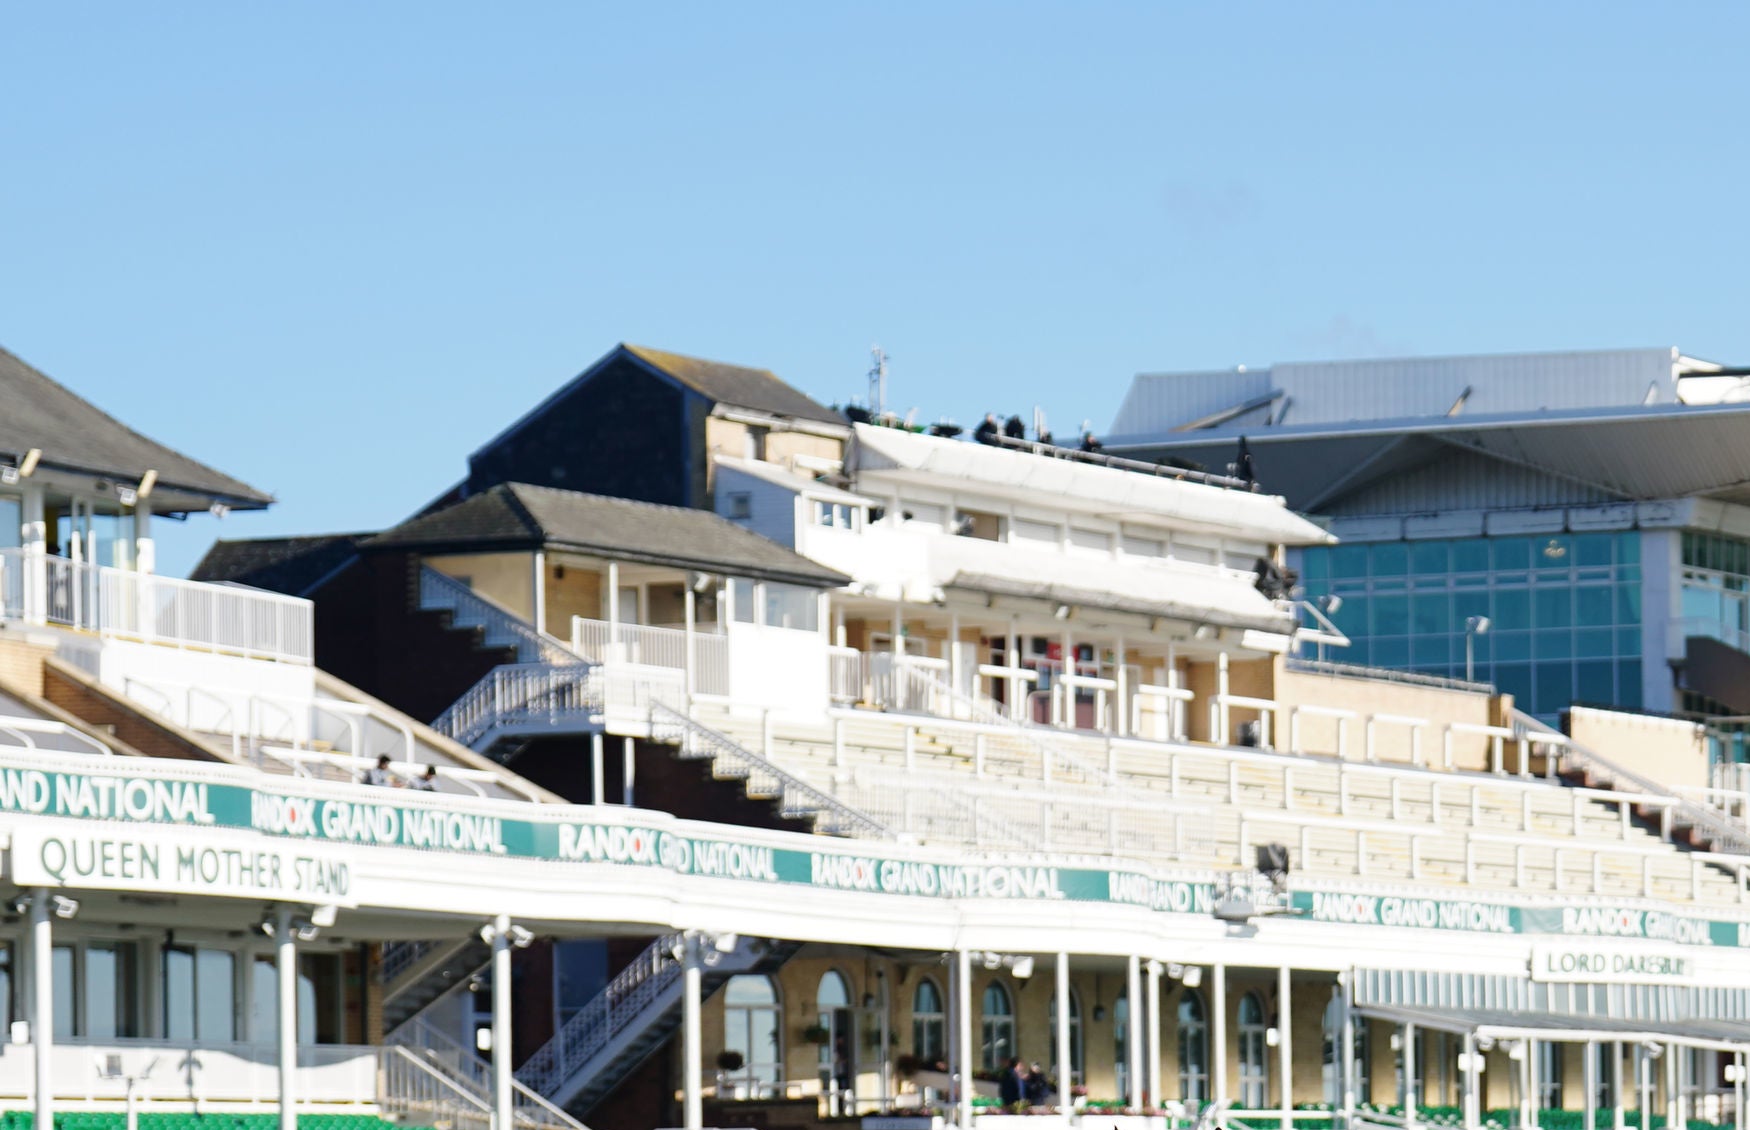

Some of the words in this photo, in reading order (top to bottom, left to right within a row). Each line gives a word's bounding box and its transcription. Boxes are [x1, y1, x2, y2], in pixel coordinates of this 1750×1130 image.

[0, 768, 49, 812] ND
[56, 773, 215, 824] NATIONAL
[322, 800, 400, 843] GRAND
[403, 809, 507, 853] NATIONAL
[558, 823, 659, 863] RANDOX
[694, 840, 778, 880] NATIONAL
[41, 837, 158, 880] QUEEN
[176, 846, 282, 888] MOTHER
[295, 857, 349, 896] STAND
[811, 852, 880, 889] RANDOX
[881, 860, 940, 894] GRAND
[939, 865, 1066, 899] NATIONAL
[1381, 896, 1438, 927] GRAND
[1547, 952, 1606, 973] LORD
